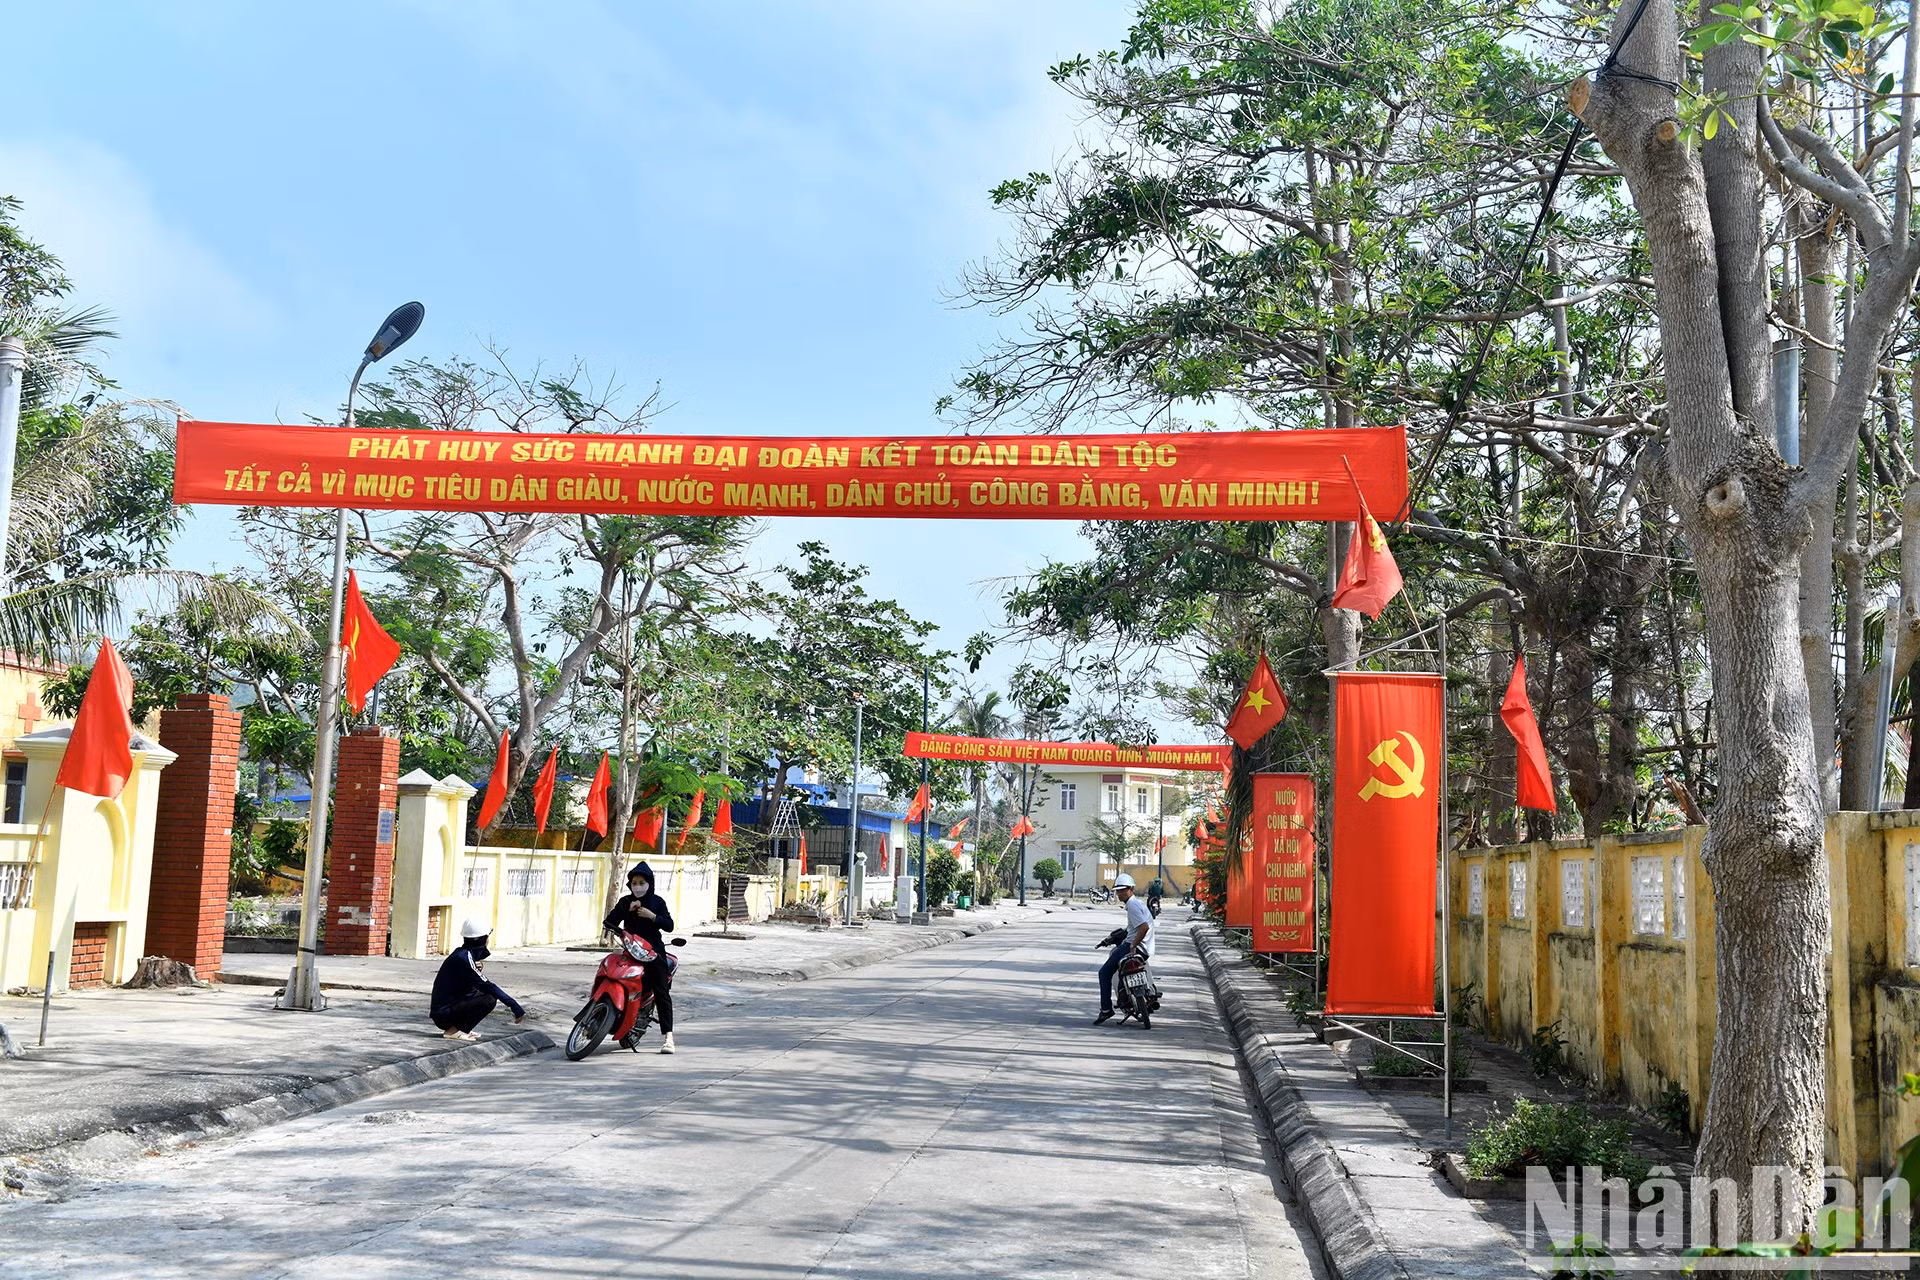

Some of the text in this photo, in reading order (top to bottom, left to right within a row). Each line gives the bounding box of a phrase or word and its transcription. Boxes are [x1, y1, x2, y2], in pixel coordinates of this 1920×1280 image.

[348, 435, 1177, 471] PHÁT HUY SỨC MẠNH ĐẠI ĐOÀN KẾT TOÀN DÂN TỘC
[224, 463, 1319, 510] TẤT CẢ VÌ MỤC TIÊU DÂN GIÀU, NƯỚC MẠNH, DÂN CHỦ, CÔNG BẰNG, VĂN MINH!
[920, 736, 951, 754] ĐẢNG
[954, 741, 985, 758] CỘNG
[988, 740, 1012, 758] SẢN
[1015, 744, 1039, 762] VIỆT
[1041, 747, 1068, 760] NAM
[1071, 748, 1112, 763] QUANG
[1115, 750, 1143, 763] VINH
[1146, 749, 1181, 764] MUÔN
[1184, 750, 1212, 764] NĂM
[1275, 786, 1297, 805] NƯỚC
[1267, 811, 1288, 832] CỘNG
[1274, 835, 1299, 857] XÃ HỘI
[1266, 857, 1307, 878] CHỦ NGHĨA
[1266, 884, 1302, 905] VIỆT NAM
[1264, 908, 1306, 926] MUÔN NĂM
